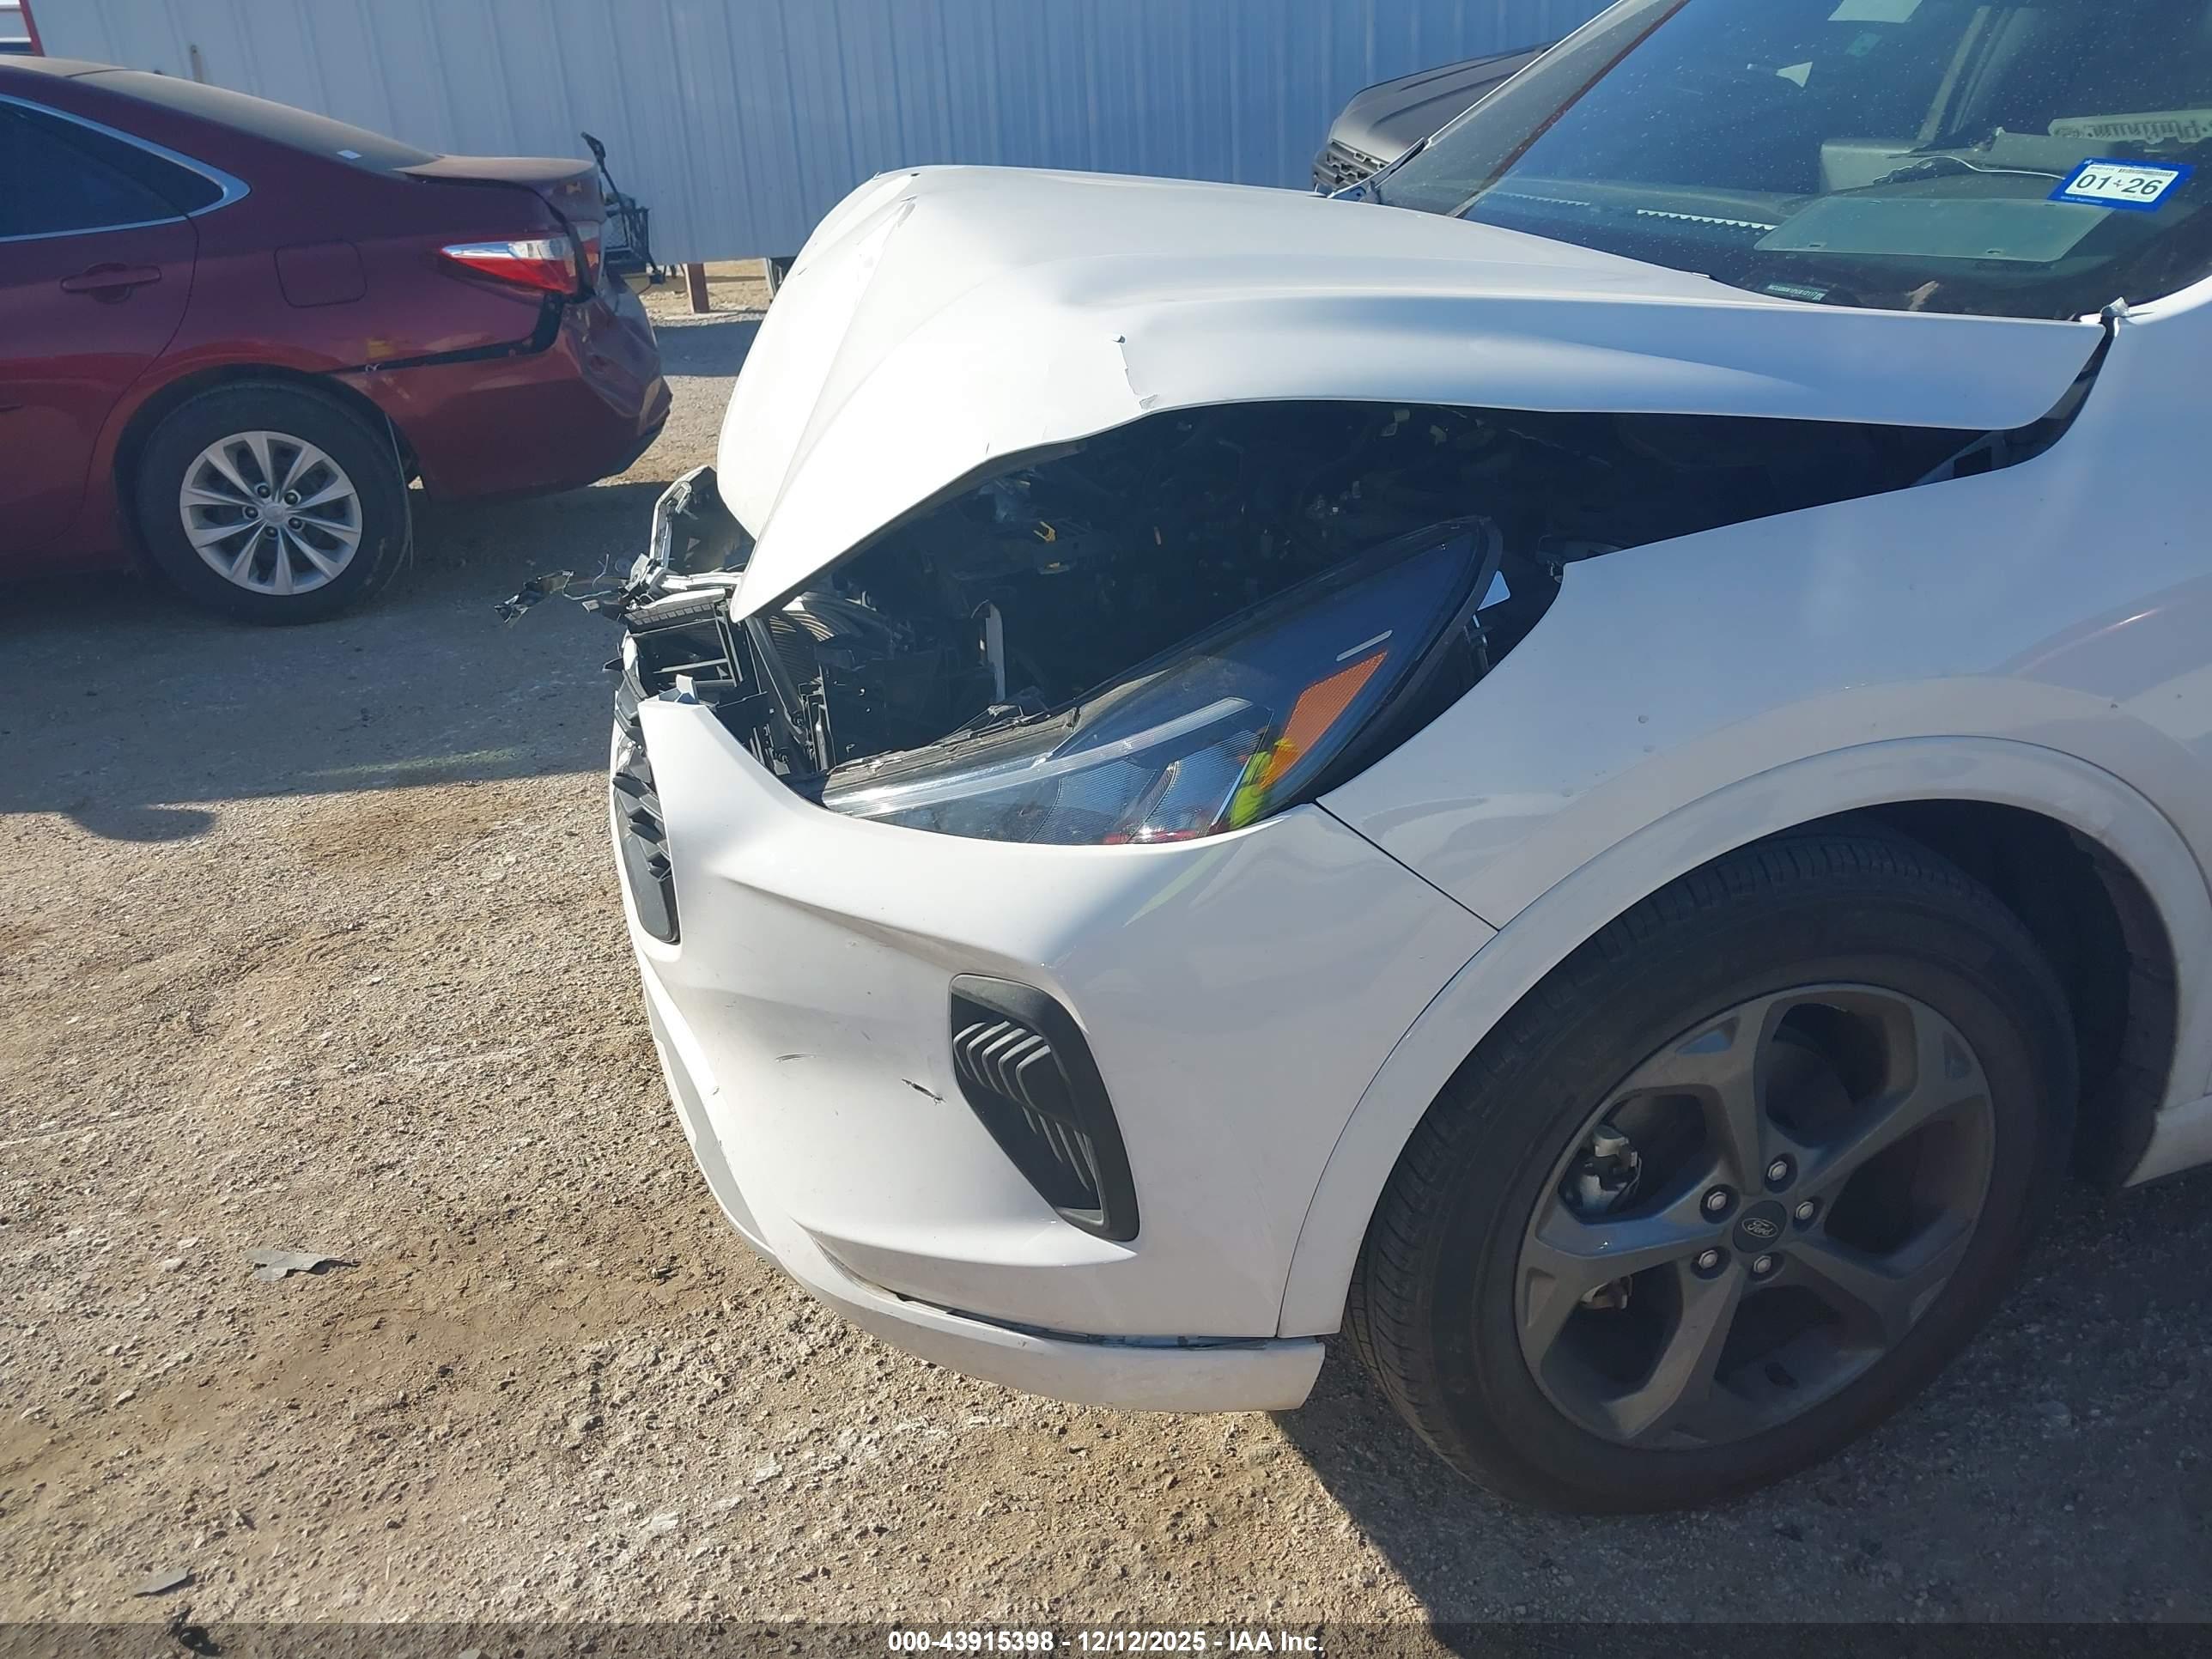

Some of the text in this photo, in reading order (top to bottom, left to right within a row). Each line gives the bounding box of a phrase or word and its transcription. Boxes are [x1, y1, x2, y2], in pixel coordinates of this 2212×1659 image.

[2076, 173, 2163, 195] 01 26
[1747, 1220, 1774, 1236] Ford
